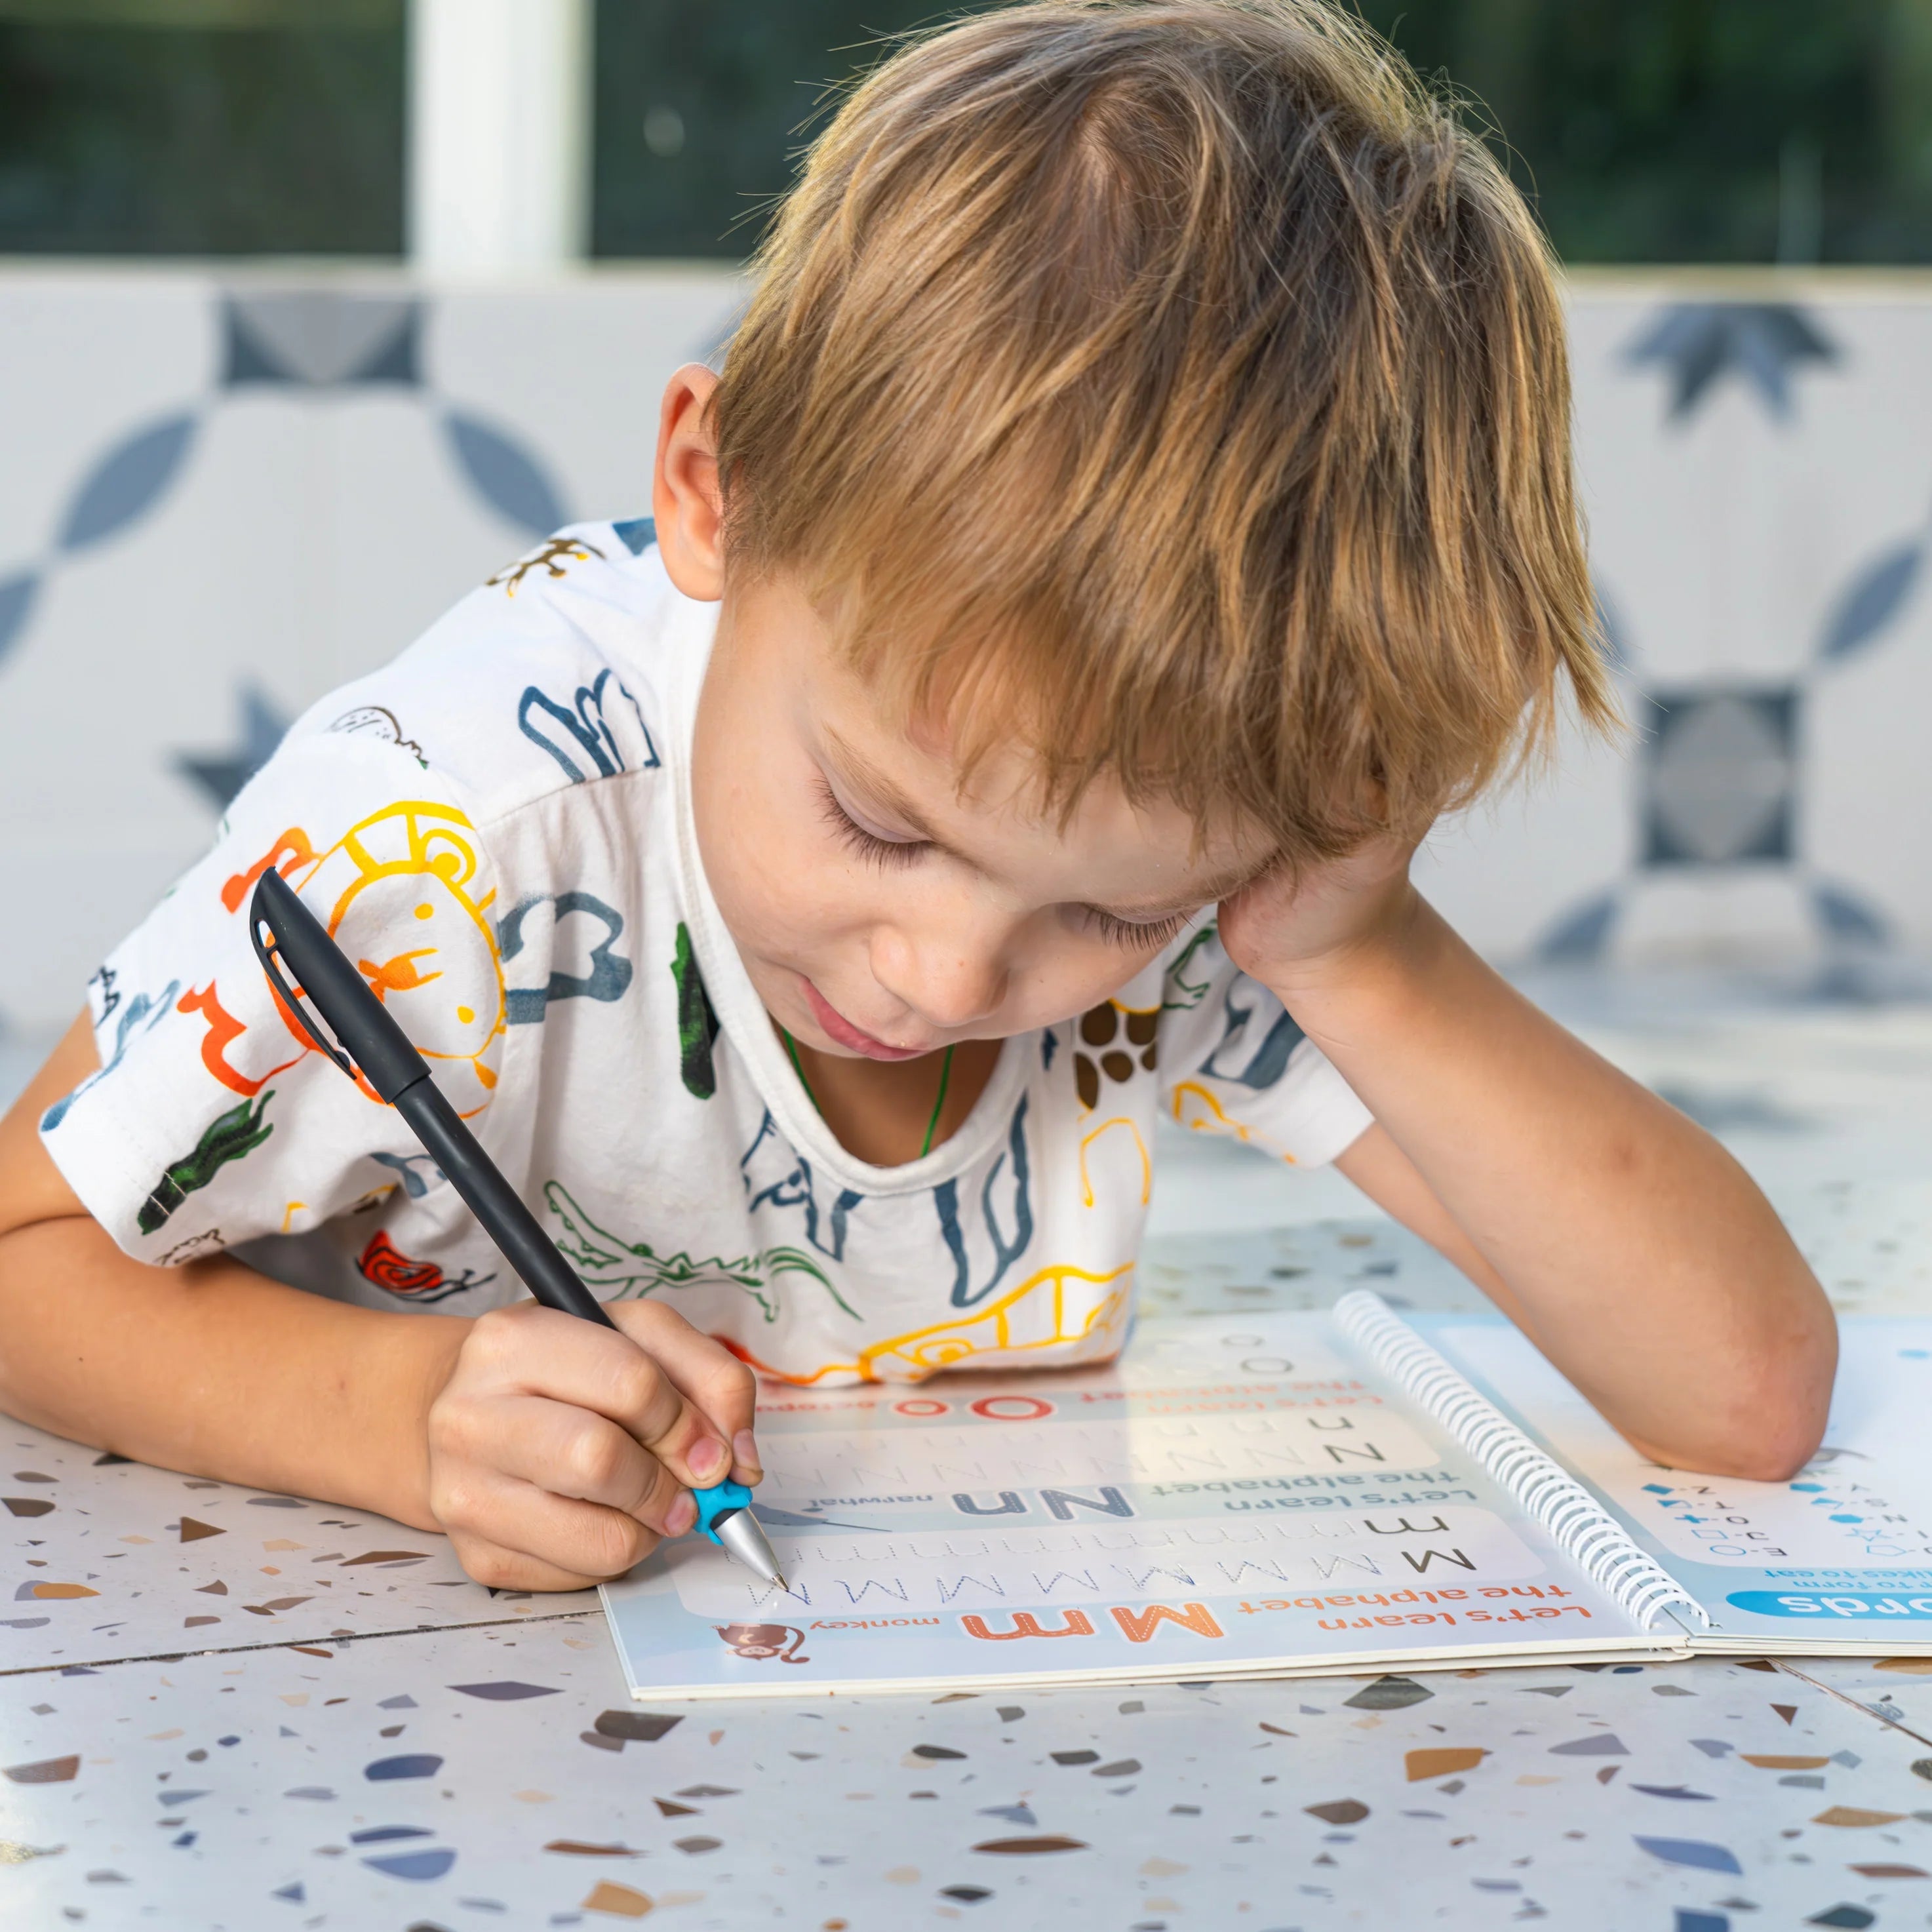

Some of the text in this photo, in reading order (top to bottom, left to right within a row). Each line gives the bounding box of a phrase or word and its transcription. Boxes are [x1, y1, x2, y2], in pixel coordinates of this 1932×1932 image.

[1307, 1416, 1355, 1430] n
[1323, 1442, 1387, 1463] N
[1151, 1472, 1460, 1497] the alphabet
[808, 1494, 933, 1507] narwhal
[1224, 1489, 1477, 1510] Let's learn
[1364, 1515, 1449, 1534] m
[1402, 1548, 1477, 1573] M
[1764, 1569, 1815, 1579] eat
[1793, 1581, 1871, 1590] form
[1238, 1585, 1571, 1615] the alphabet
[810, 1616, 940, 1631] monkey
[1318, 1605, 1592, 1630] Let's learn
